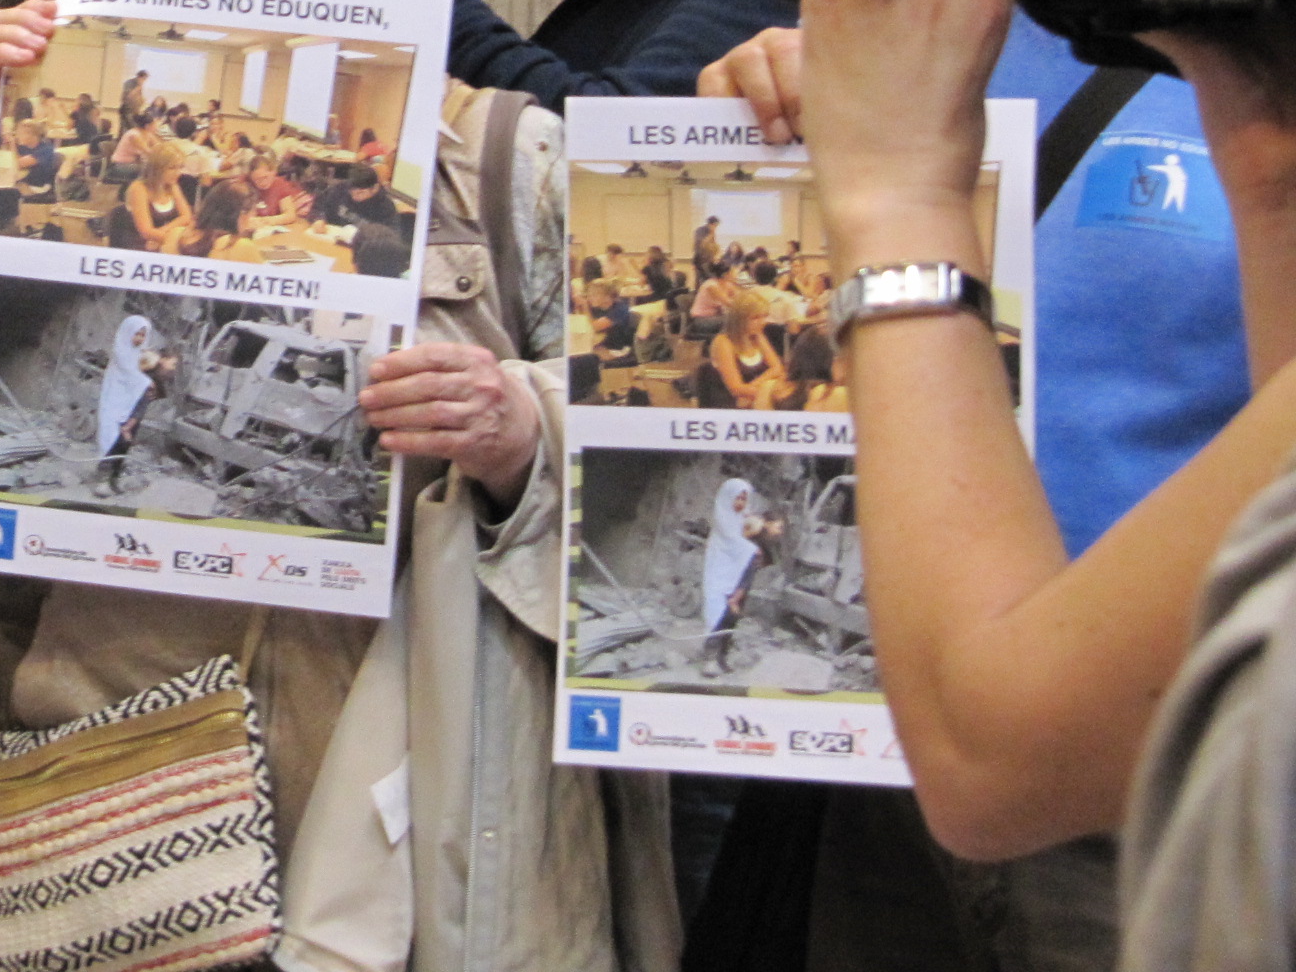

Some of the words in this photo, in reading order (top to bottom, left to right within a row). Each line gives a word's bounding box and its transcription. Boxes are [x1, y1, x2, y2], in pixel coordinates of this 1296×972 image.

[629, 125, 676, 145] LES
[80, 257, 124, 279] LES
[131, 263, 219, 288] ARMES
[224, 272, 321, 300] MATEN!
[670, 420, 718, 441] LES
[725, 422, 817, 444] ARMES
